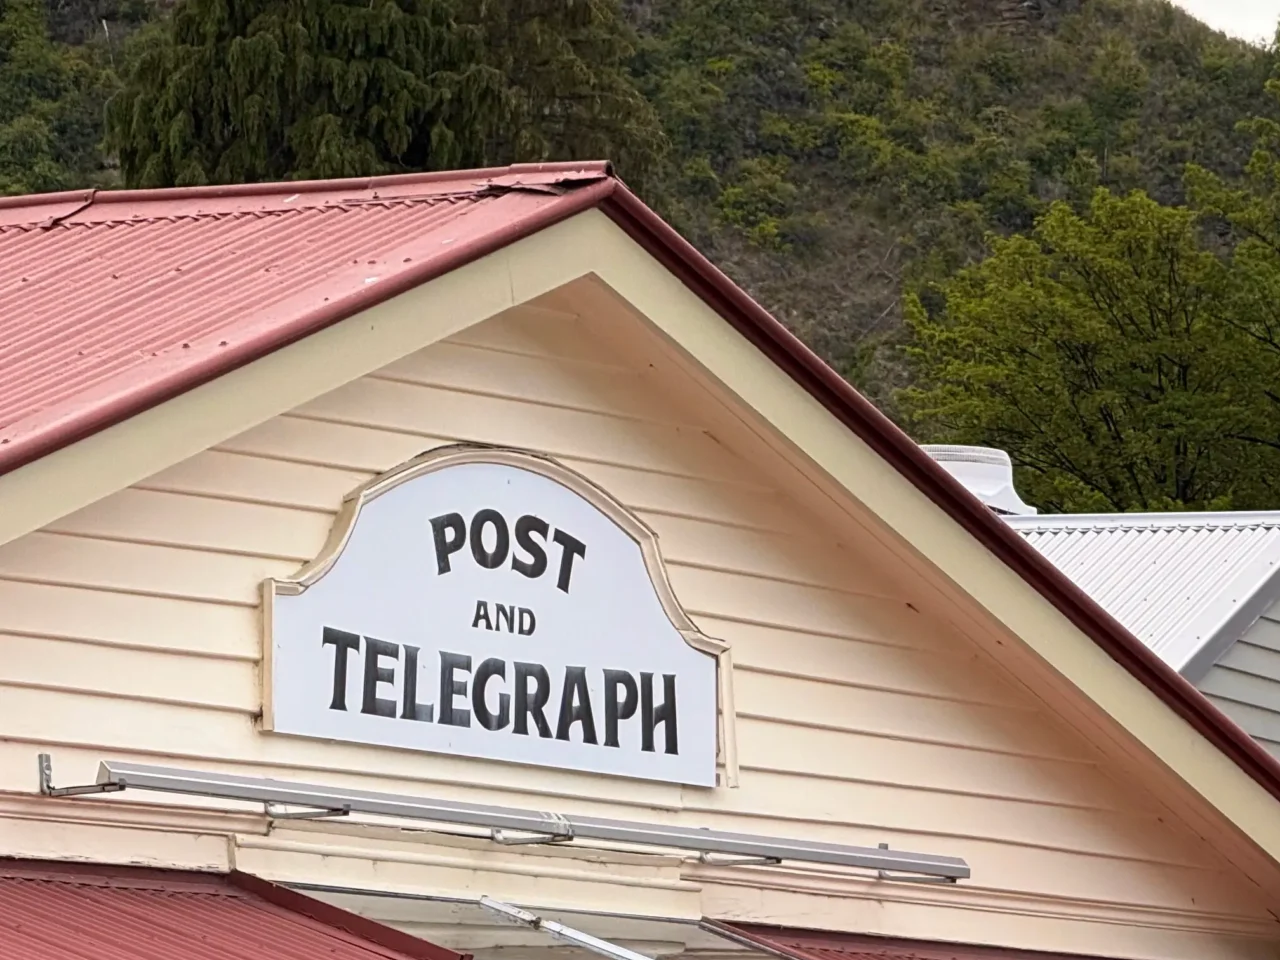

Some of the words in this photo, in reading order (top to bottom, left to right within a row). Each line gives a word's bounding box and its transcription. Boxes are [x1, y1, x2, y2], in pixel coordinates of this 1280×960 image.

[429, 509, 586, 593] POST
[472, 600, 536, 636] AND
[322, 626, 678, 755] TELEGRAPH
